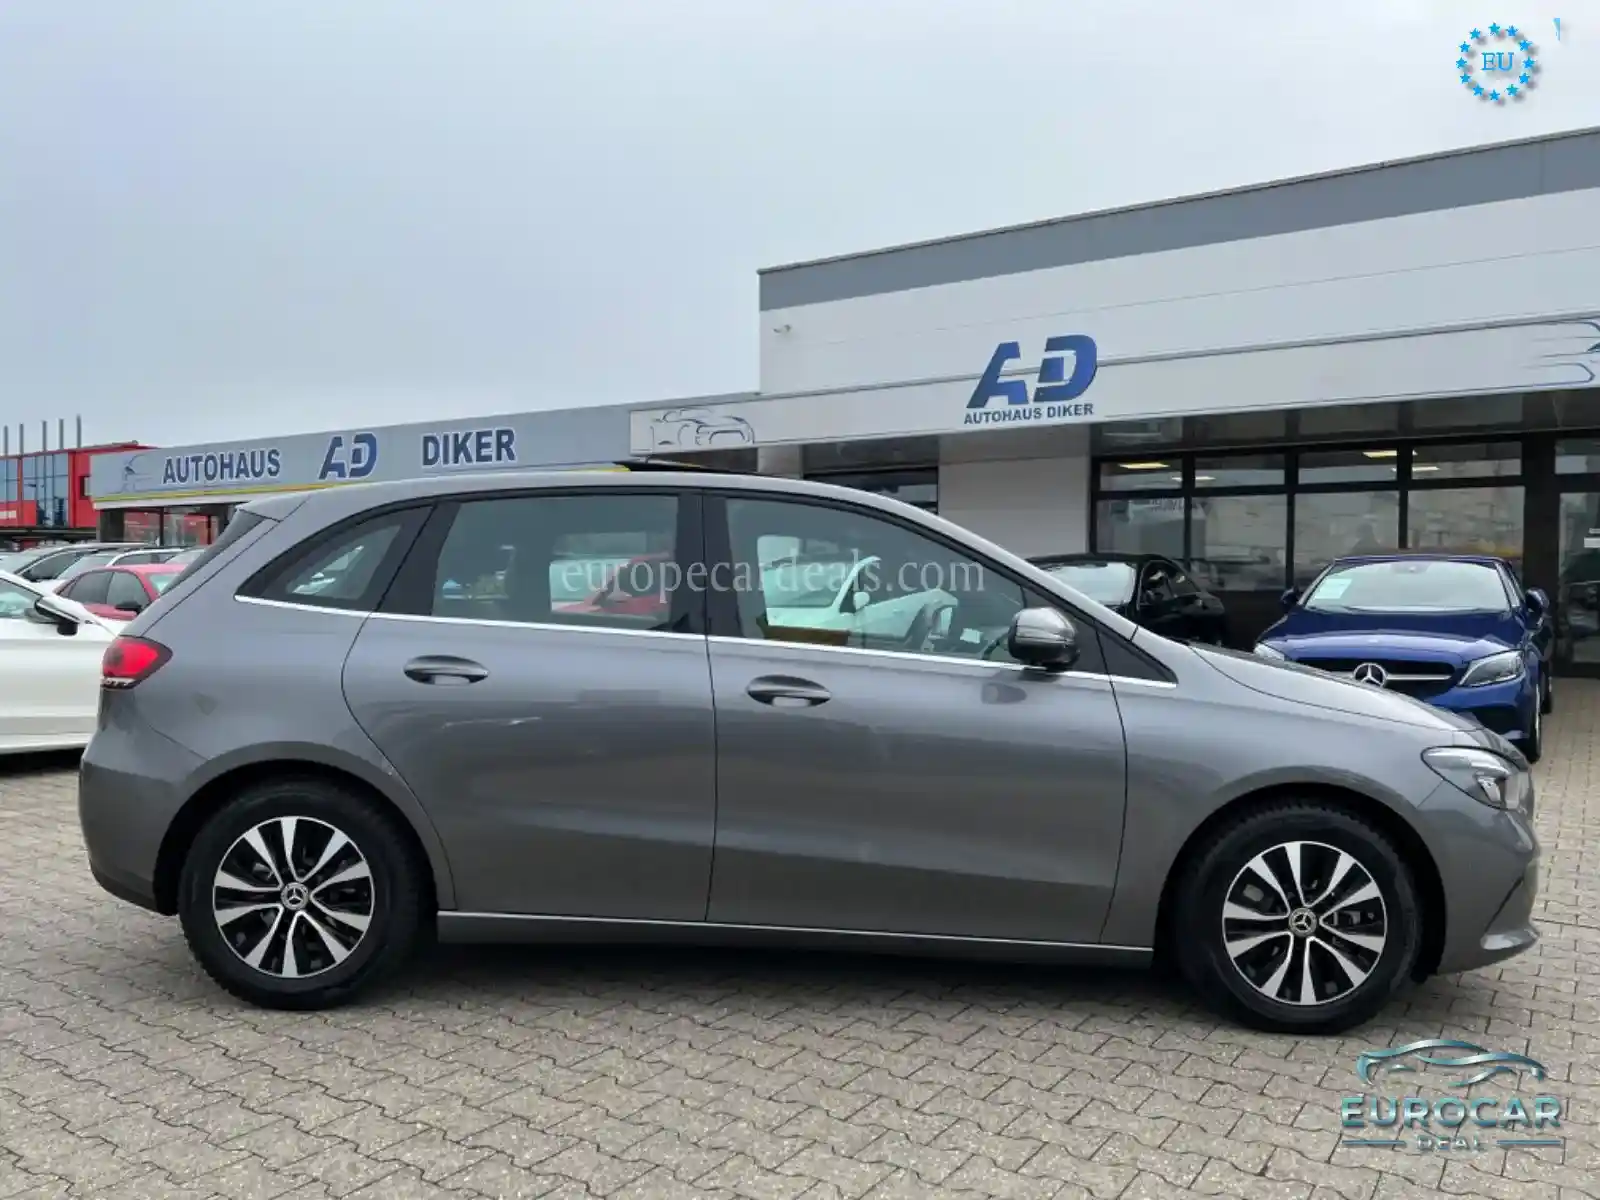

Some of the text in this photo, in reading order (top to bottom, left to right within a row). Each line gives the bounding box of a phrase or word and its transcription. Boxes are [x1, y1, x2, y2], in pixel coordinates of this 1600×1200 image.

[966, 334, 1097, 409] AD
[964, 402, 1094, 425] AUTOHAUS DIKER
[161, 429, 516, 485] AUTOHAUS AD DIKER
